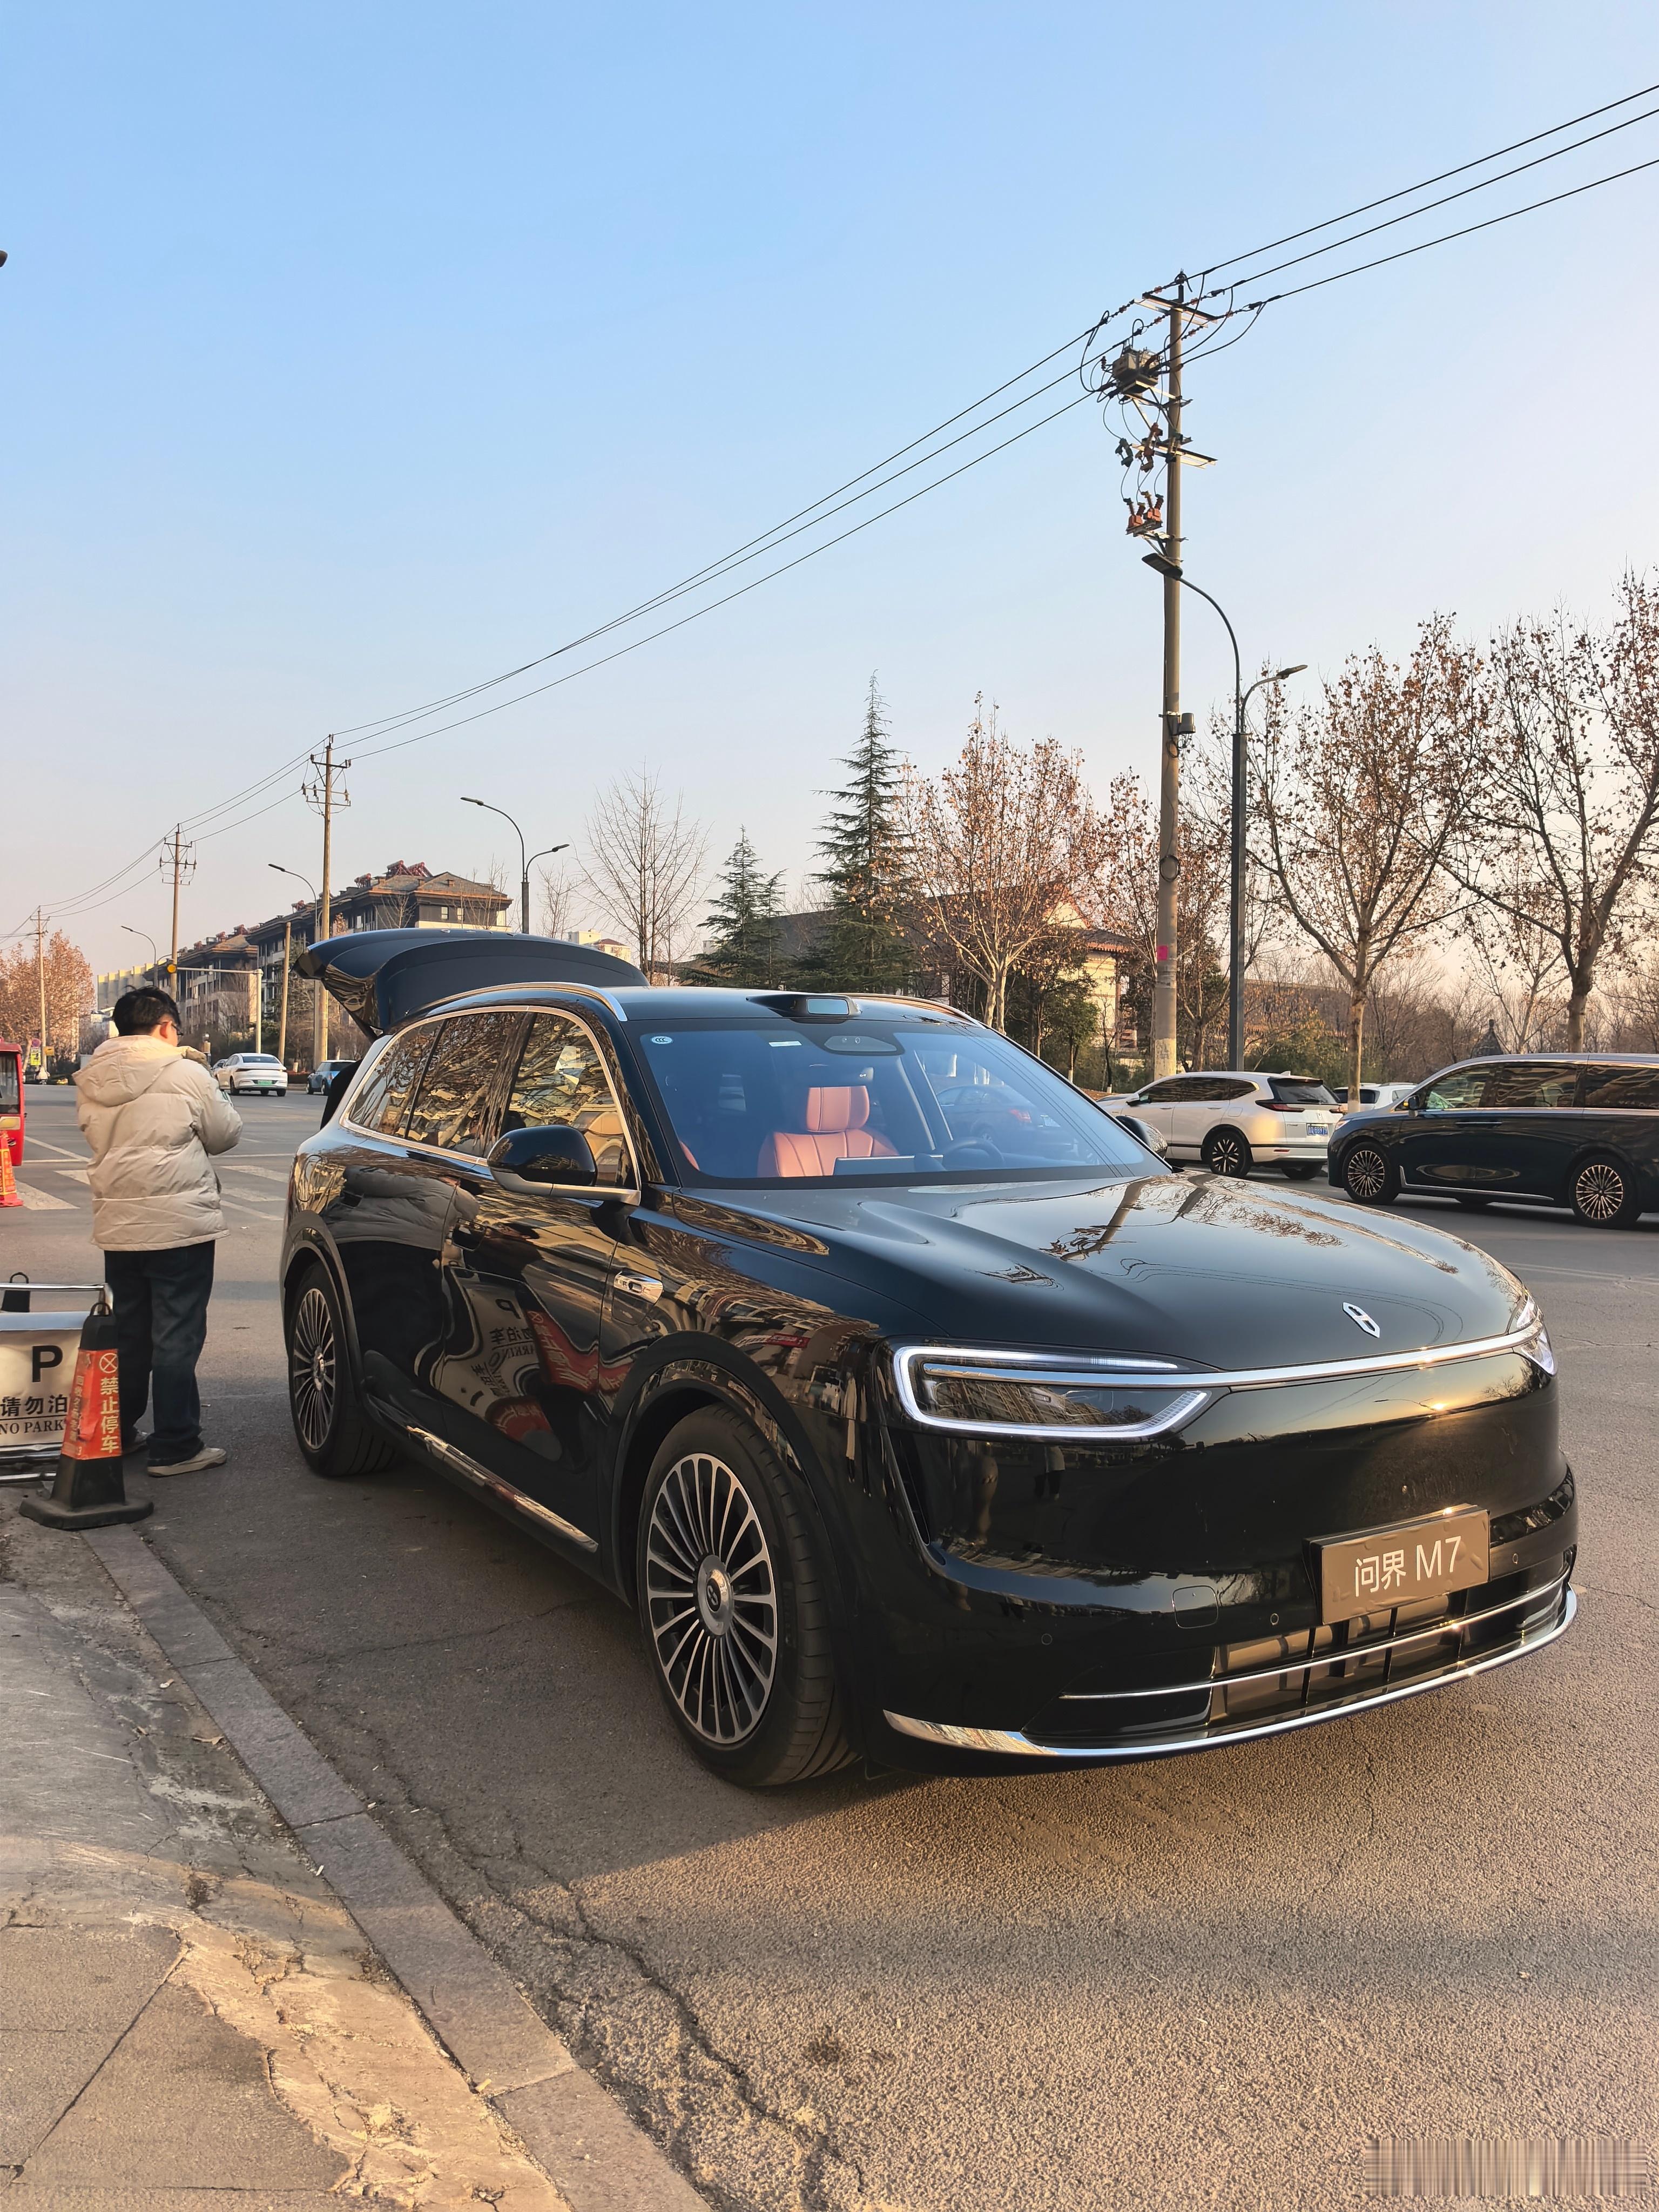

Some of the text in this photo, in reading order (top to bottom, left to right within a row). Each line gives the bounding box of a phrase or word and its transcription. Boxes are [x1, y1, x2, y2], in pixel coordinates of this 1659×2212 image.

[32, 1345, 63, 1382] P
[0, 1394, 68, 1417] 请勿泊
[100, 1377, 119, 1453] 禁止停车
[0, 1422, 19, 1434] NO
[1355, 1535, 1461, 1597] 问界 M7
